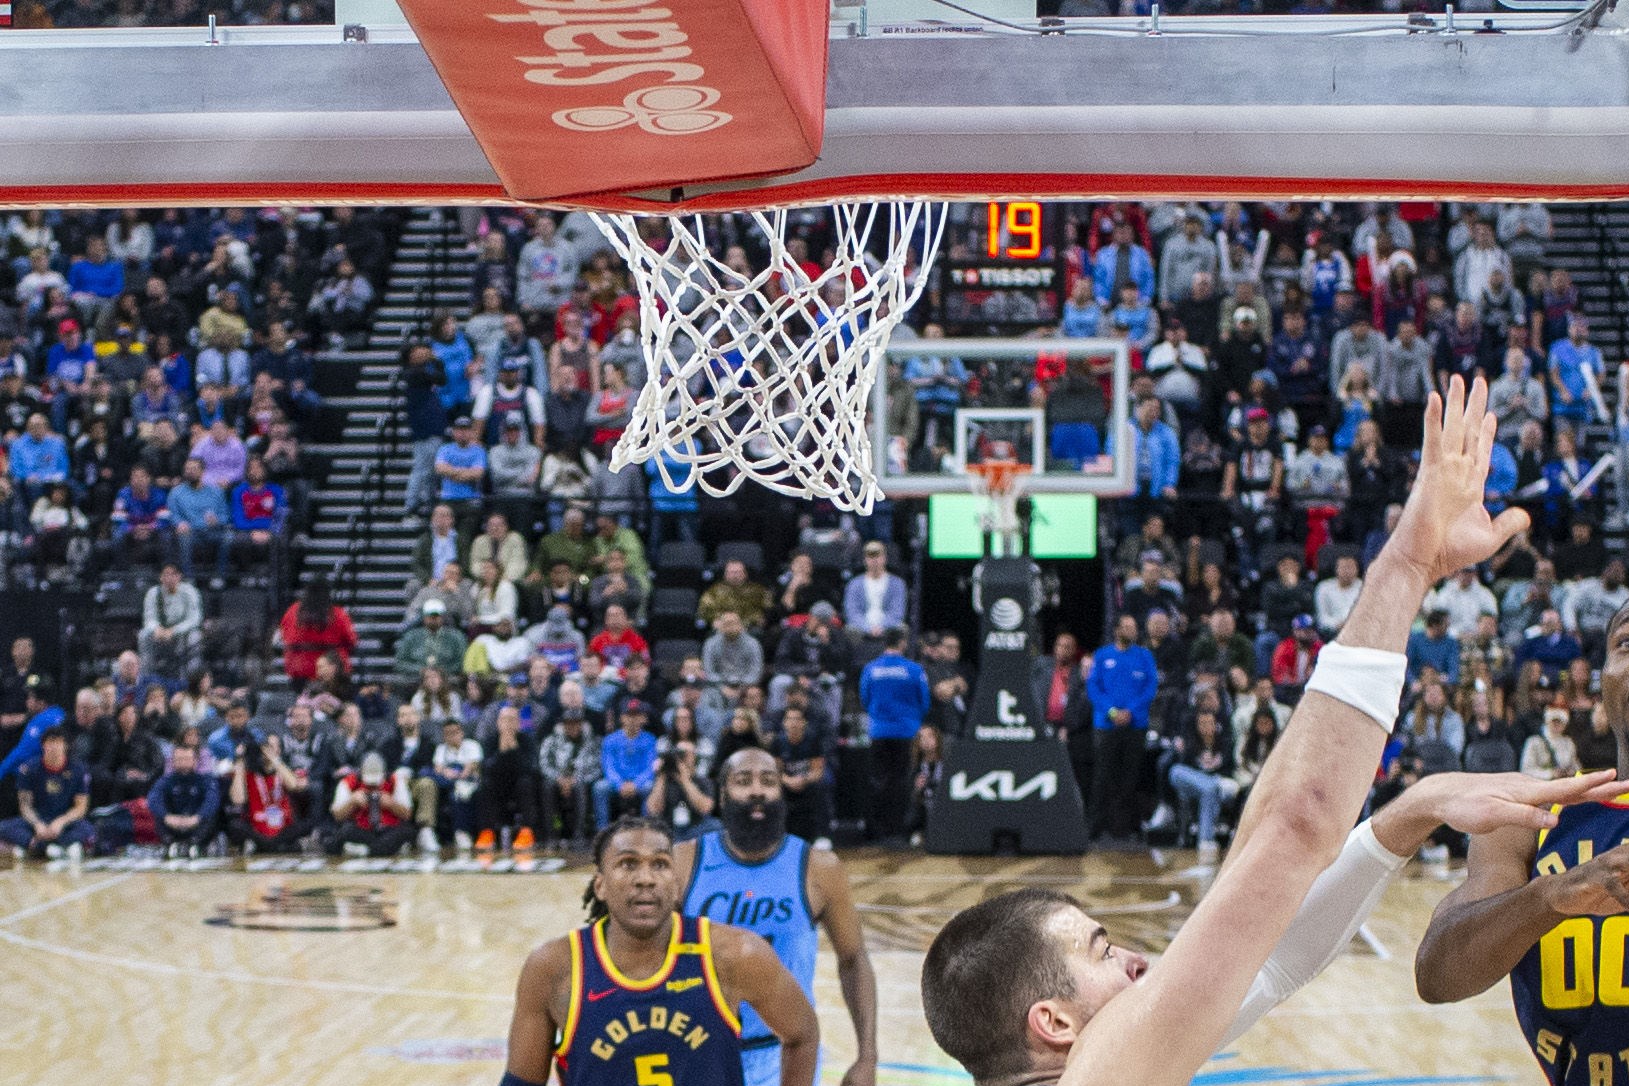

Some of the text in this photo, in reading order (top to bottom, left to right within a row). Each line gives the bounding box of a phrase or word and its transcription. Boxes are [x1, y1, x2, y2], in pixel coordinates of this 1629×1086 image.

[987, 202, 1043, 259] 19
[980, 268, 1054, 287] TISSOT
[950, 769, 1058, 801] KIA
[700, 890, 794, 925] Clips
[591, 1006, 710, 1061] GOLDEN
